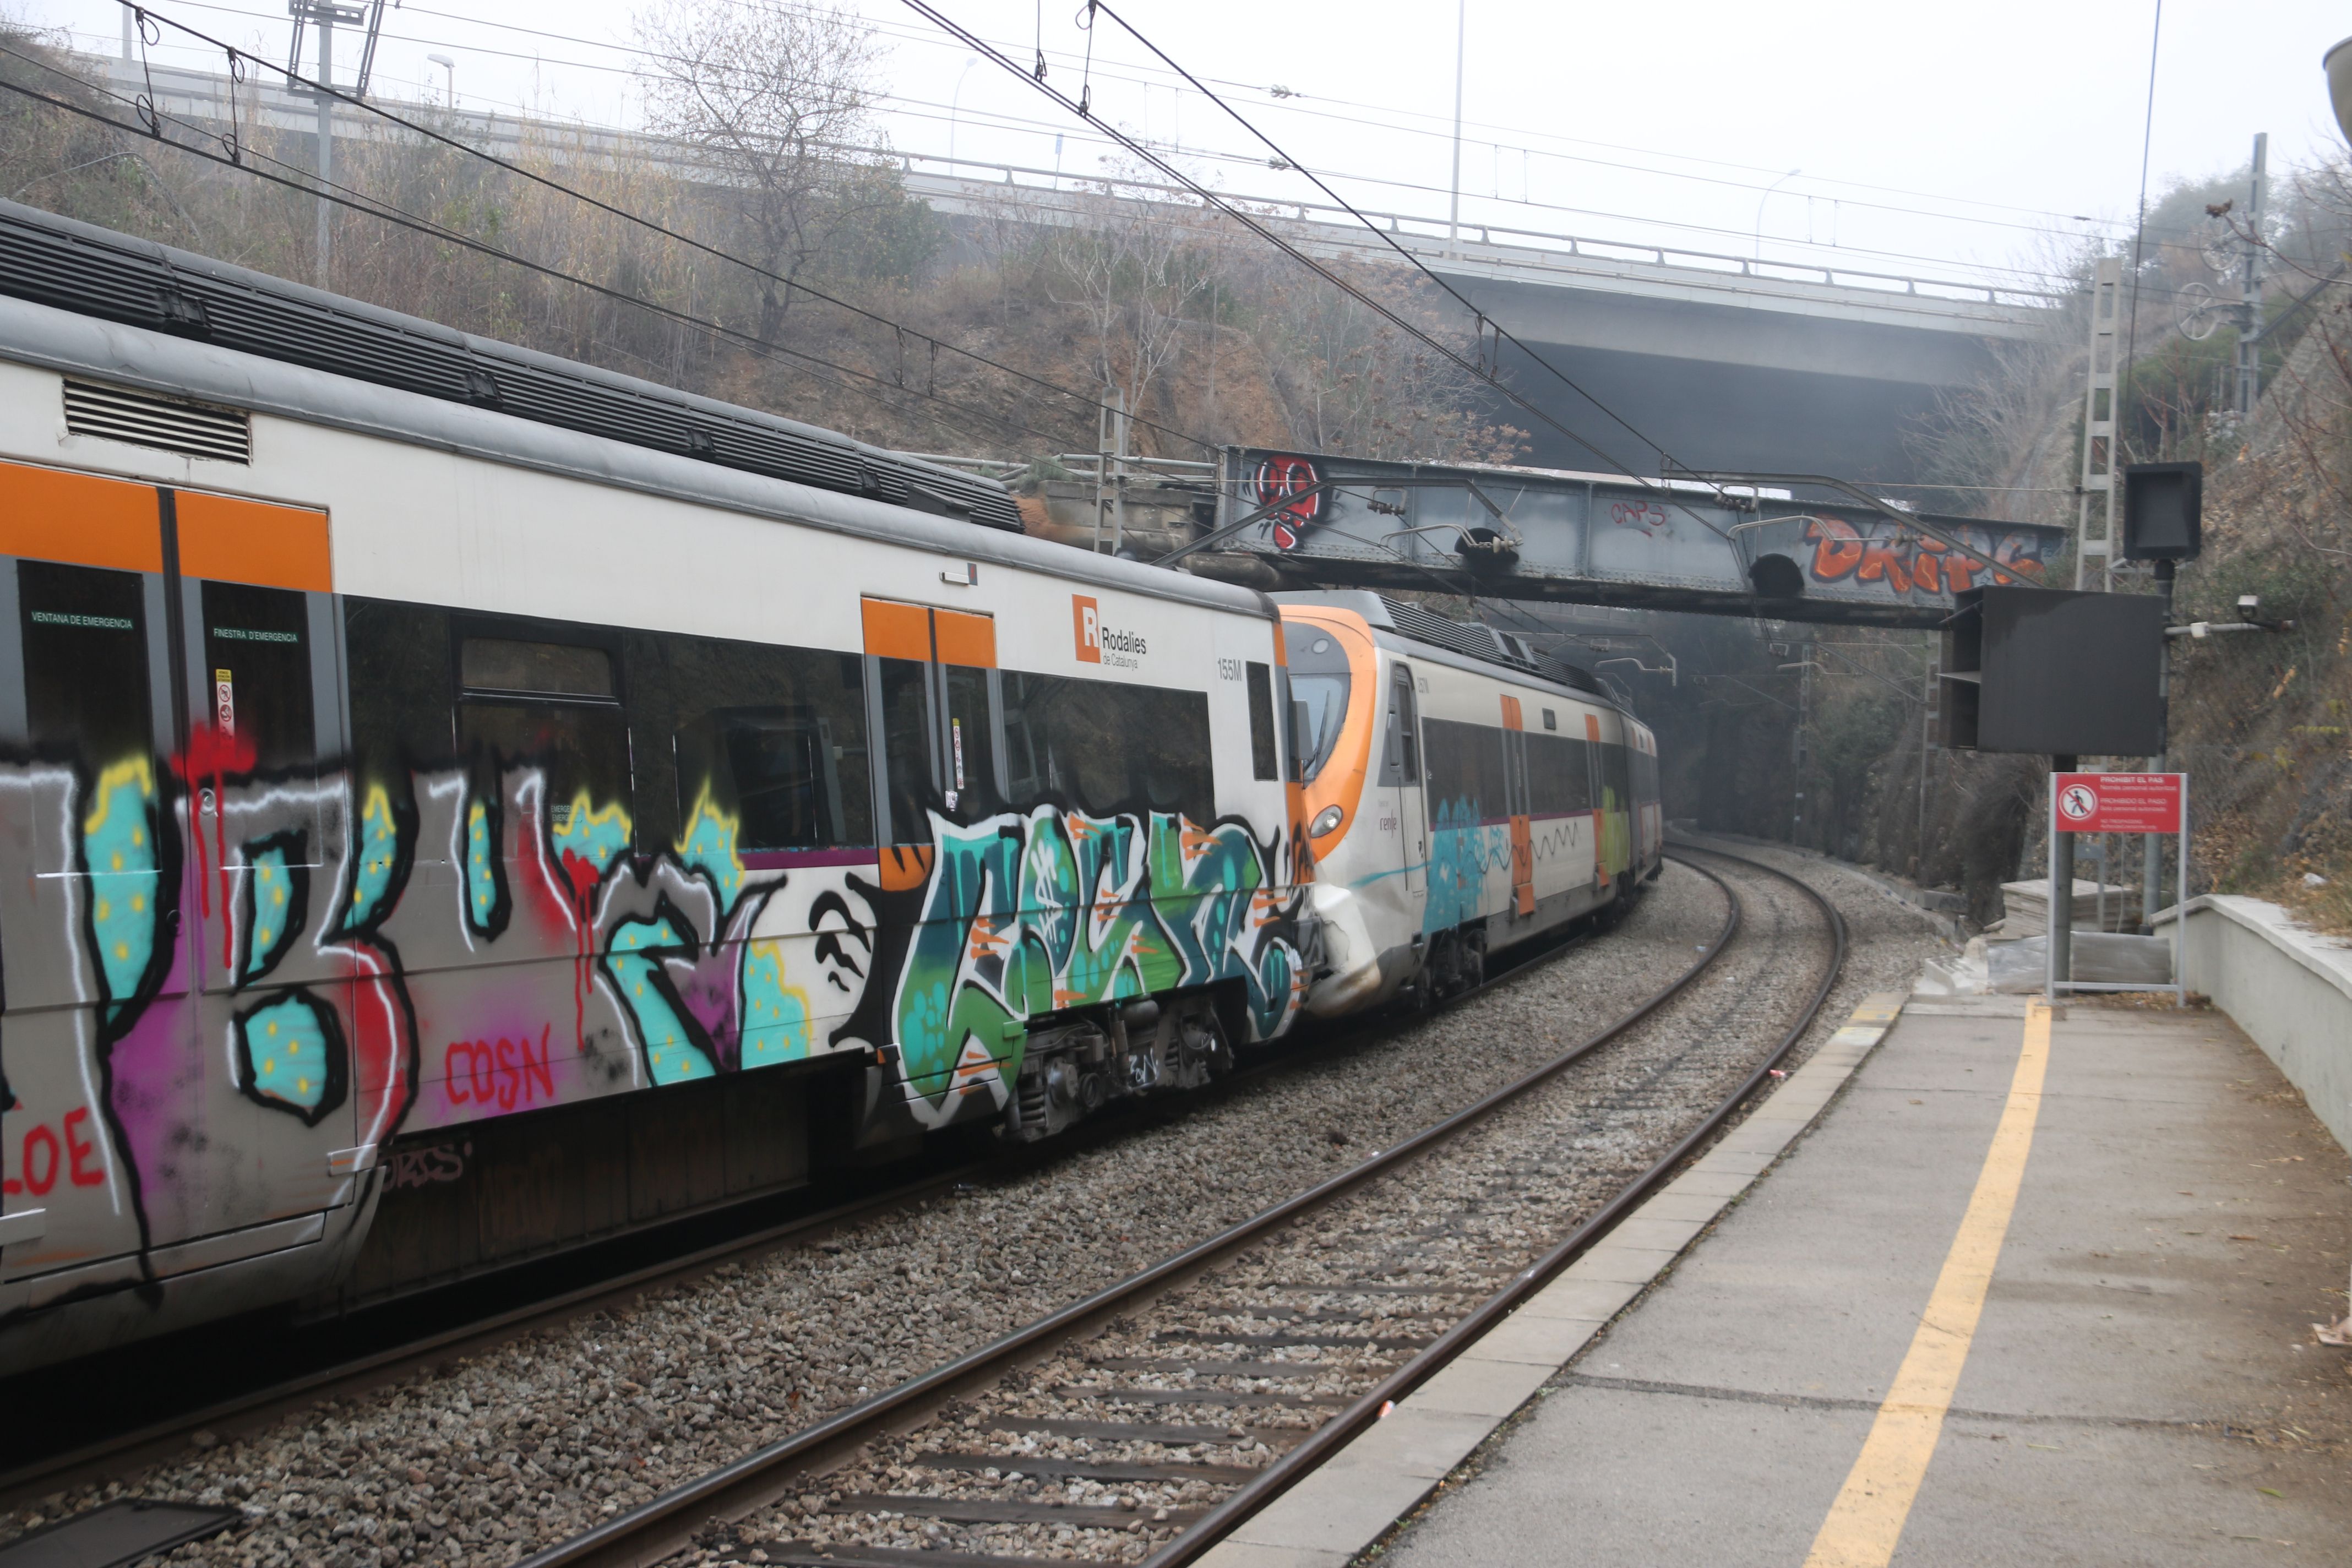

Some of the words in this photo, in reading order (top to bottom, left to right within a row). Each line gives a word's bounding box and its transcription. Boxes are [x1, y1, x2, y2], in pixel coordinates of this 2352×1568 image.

[1611, 499, 1665, 526] CAPS
[31, 611, 69, 623] VENTANA
[70, 615, 81, 625] DE
[83, 616, 133, 628] EMERGENCIA
[1082, 606, 1099, 647] R
[214, 628, 248, 639] FINESTRA
[1102, 627, 1147, 655] Rodalies
[1103, 653, 1111, 666] de
[1111, 654, 1138, 672] Catalunya
[1217, 657, 1242, 682] 155M
